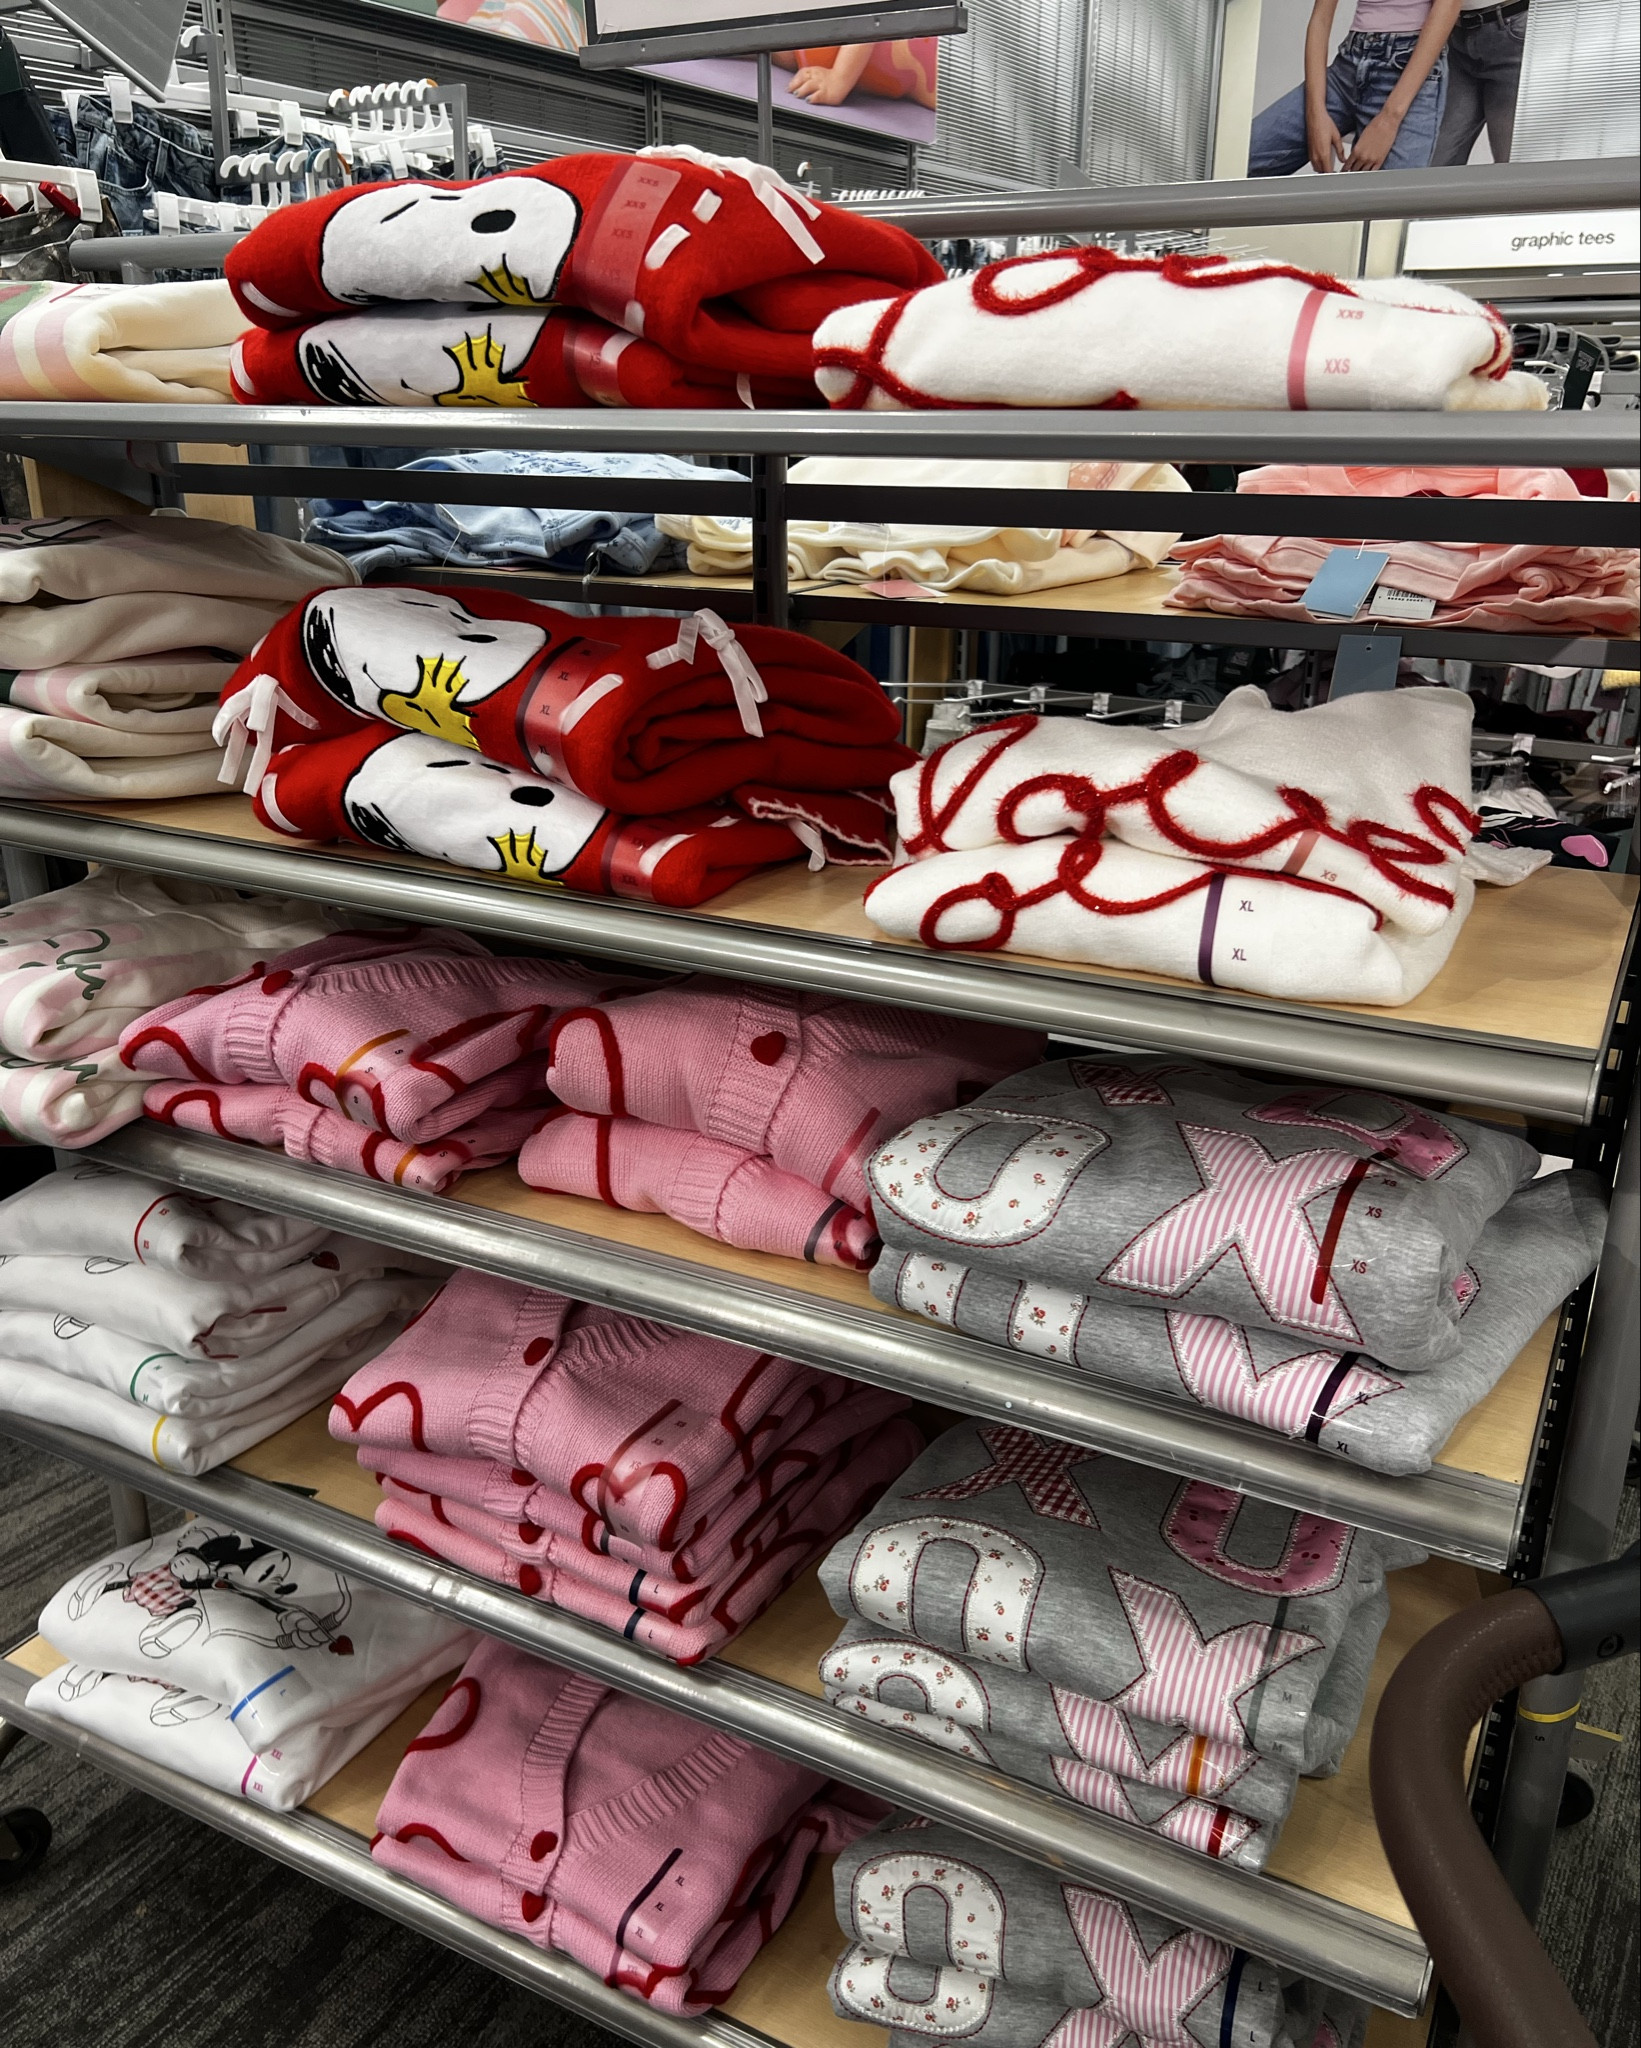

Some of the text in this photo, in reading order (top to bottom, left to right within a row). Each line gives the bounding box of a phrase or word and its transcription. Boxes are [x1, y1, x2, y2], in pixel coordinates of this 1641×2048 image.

[637, 176, 660, 187] XXS
[622, 199, 647, 210] XXS
[610, 228, 634, 239] XXS
[1511, 231, 1616, 251] graphic tees
[1336, 308, 1365, 320] XXS
[1323, 357, 1351, 374] XXS
[1319, 869, 1338, 882] XS
[1239, 899, 1255, 912] XL
[1231, 947, 1247, 961] XL
[1381, 1178, 1397, 1187] XS
[1365, 1205, 1382, 1218] XS
[1350, 1259, 1367, 1274] XS
[1335, 1440, 1350, 1455] XL
[653, 1583, 660, 1595] L
[647, 1628, 653, 1640] L
[1282, 1691, 1292, 1703] M
[1257, 1981, 1264, 1992] L
[1249, 2030, 1255, 2043] L
